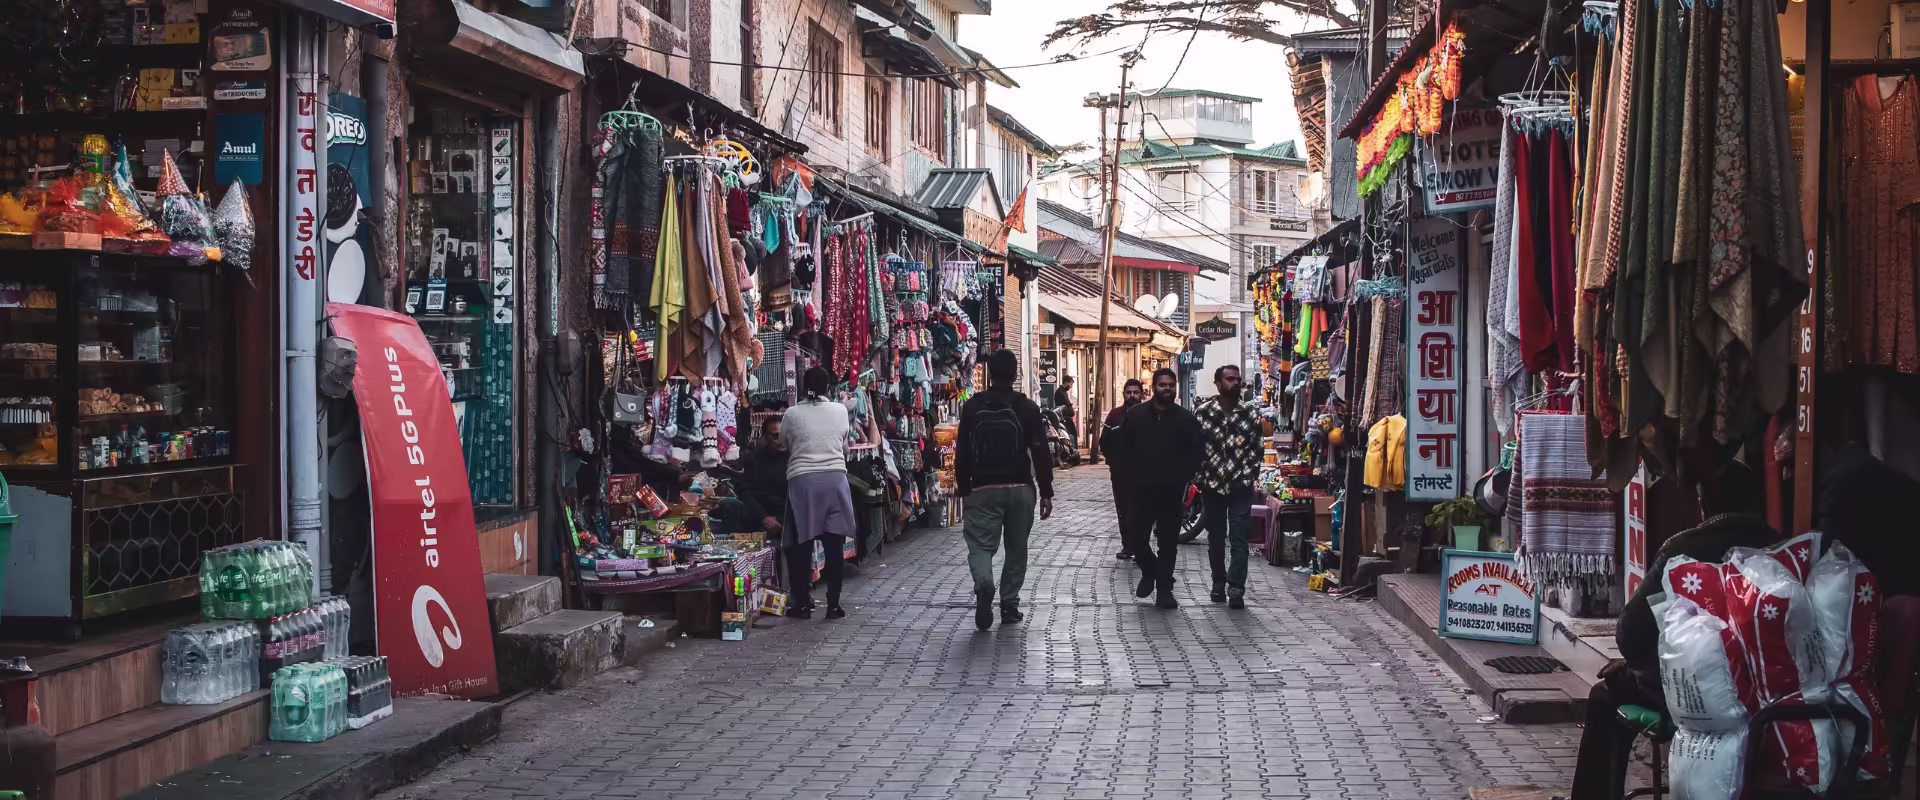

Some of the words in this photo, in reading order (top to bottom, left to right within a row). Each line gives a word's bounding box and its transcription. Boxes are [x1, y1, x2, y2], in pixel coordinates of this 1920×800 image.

[222, 141, 256, 154] Amul
[1440, 140, 1500, 163] HOTE
[1427, 168, 1483, 191] SNOW
[1411, 231, 1456, 253] Welcome
[384, 347, 413, 417] Plus
[1417, 290, 1458, 469] आशियाना
[1800, 366, 1811, 394] 51
[1799, 405, 1810, 433] 51
[402, 421, 425, 465] 5G
[415, 476, 440, 565] airtel
[1448, 564, 1480, 594] ROOMS
[1474, 584, 1502, 595] AT
[1447, 599, 1498, 616] Reasonable
[1502, 603, 1532, 618] Rates
[448, 678, 463, 691] Gift
[464, 676, 488, 688] House
